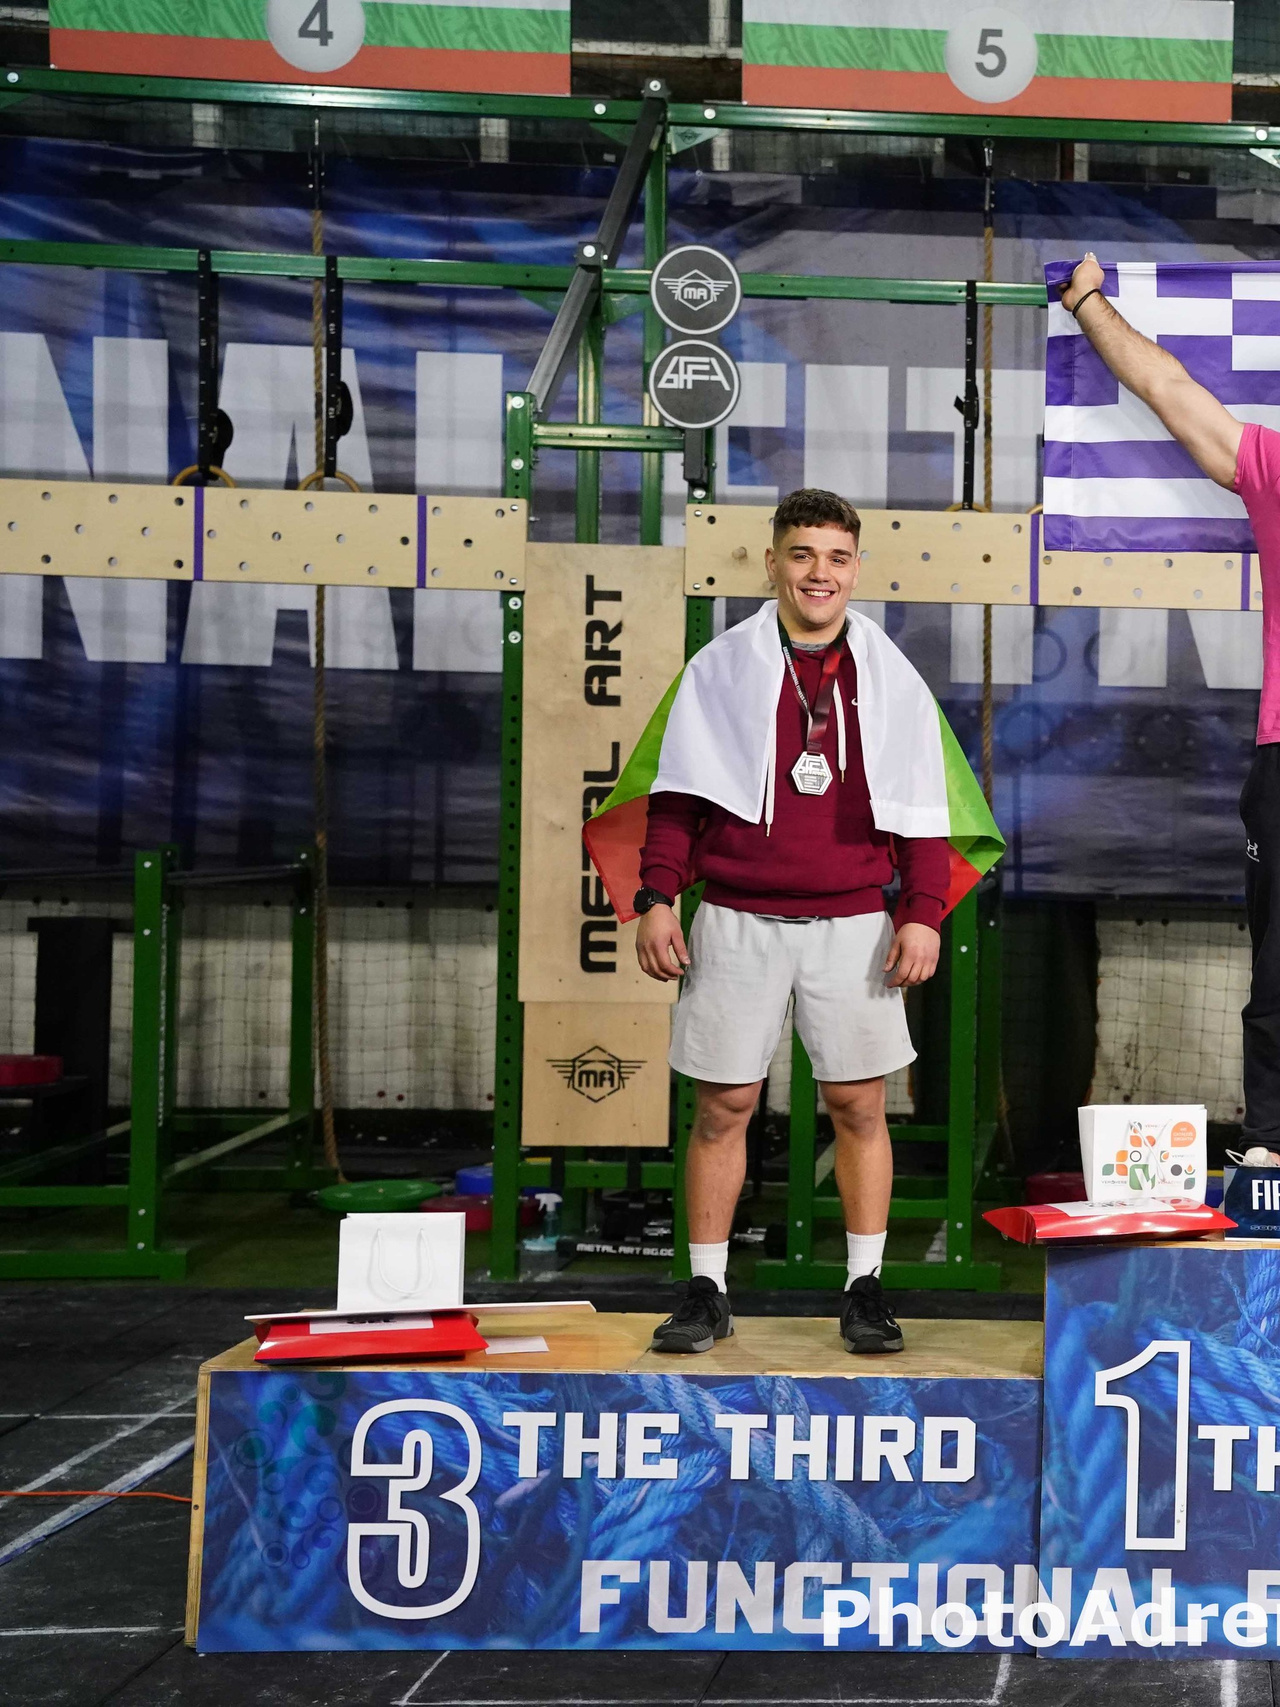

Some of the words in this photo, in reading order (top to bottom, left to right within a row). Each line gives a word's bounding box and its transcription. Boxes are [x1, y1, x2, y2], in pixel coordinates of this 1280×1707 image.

[297, 0, 333, 46] 4
[975, 28, 1007, 78] 5
[584, 574, 623, 706] ART
[503, 1412, 678, 1479] THE
[715, 1413, 976, 1483] THIRD
[1094, 1340, 1191, 1550] 1
[347, 1399, 482, 1620] 3
